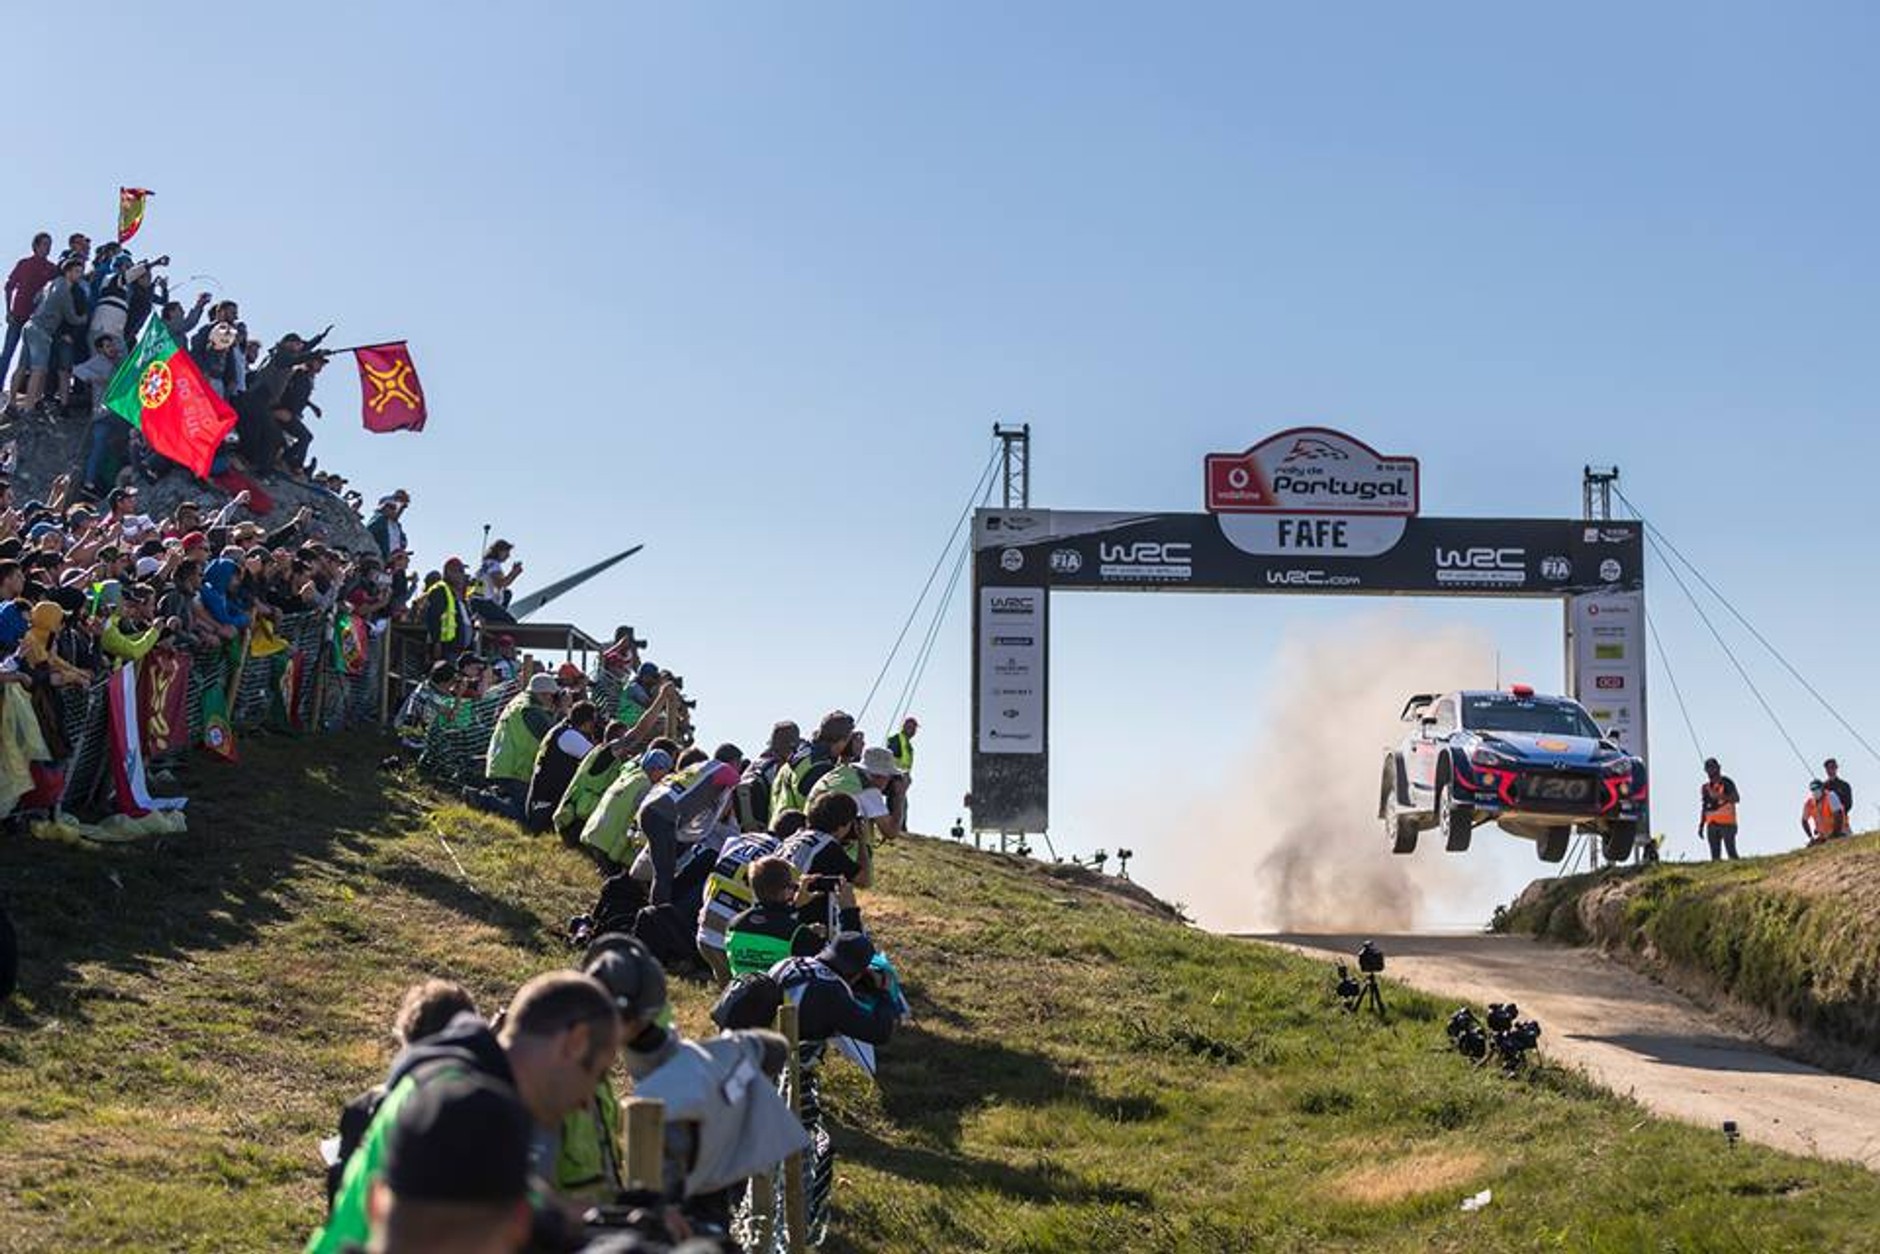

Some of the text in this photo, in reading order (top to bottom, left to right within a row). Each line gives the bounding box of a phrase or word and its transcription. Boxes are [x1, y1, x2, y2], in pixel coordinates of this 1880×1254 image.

[1274, 466, 1324, 477] rally de
[1273, 476, 1408, 500] Portugal
[1278, 519, 1348, 548] FAFE
[1051, 553, 1080, 570] FIA
[1100, 542, 1192, 563] WRC
[1436, 548, 1526, 568] WRC
[1541, 559, 1569, 576] FIA
